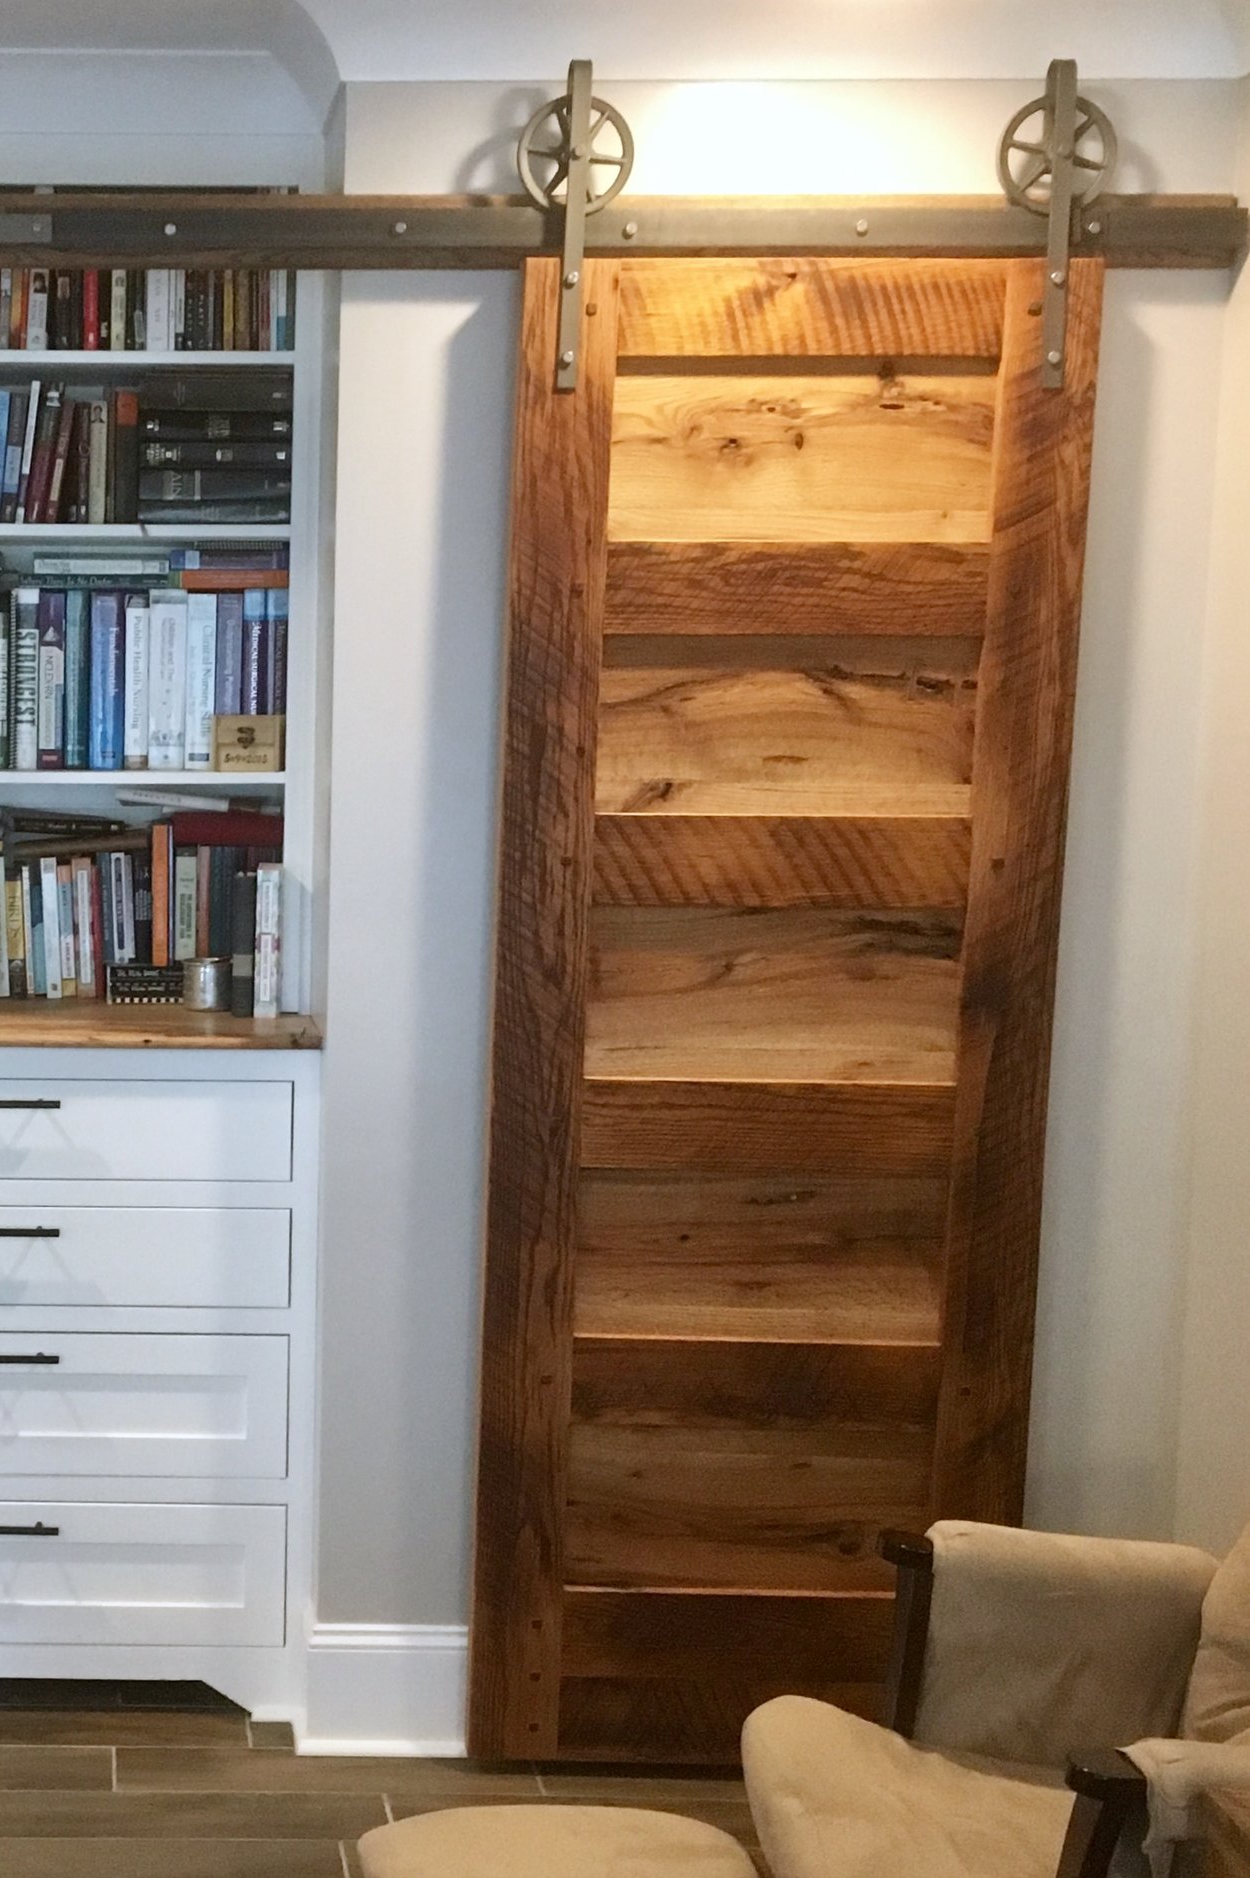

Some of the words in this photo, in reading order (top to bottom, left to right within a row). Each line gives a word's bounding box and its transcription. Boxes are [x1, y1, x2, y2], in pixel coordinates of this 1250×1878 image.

[133, 615, 142, 648] Public
[202, 624, 213, 665] Clinical
[16, 631, 37, 727] STRONGEST
[109, 627, 119, 697] Fundamentals
[133, 651, 142, 685] Health
[200, 668, 212, 708] Nursing
[131, 688, 141, 730] Nursing
[200, 710, 212, 738] Skills
